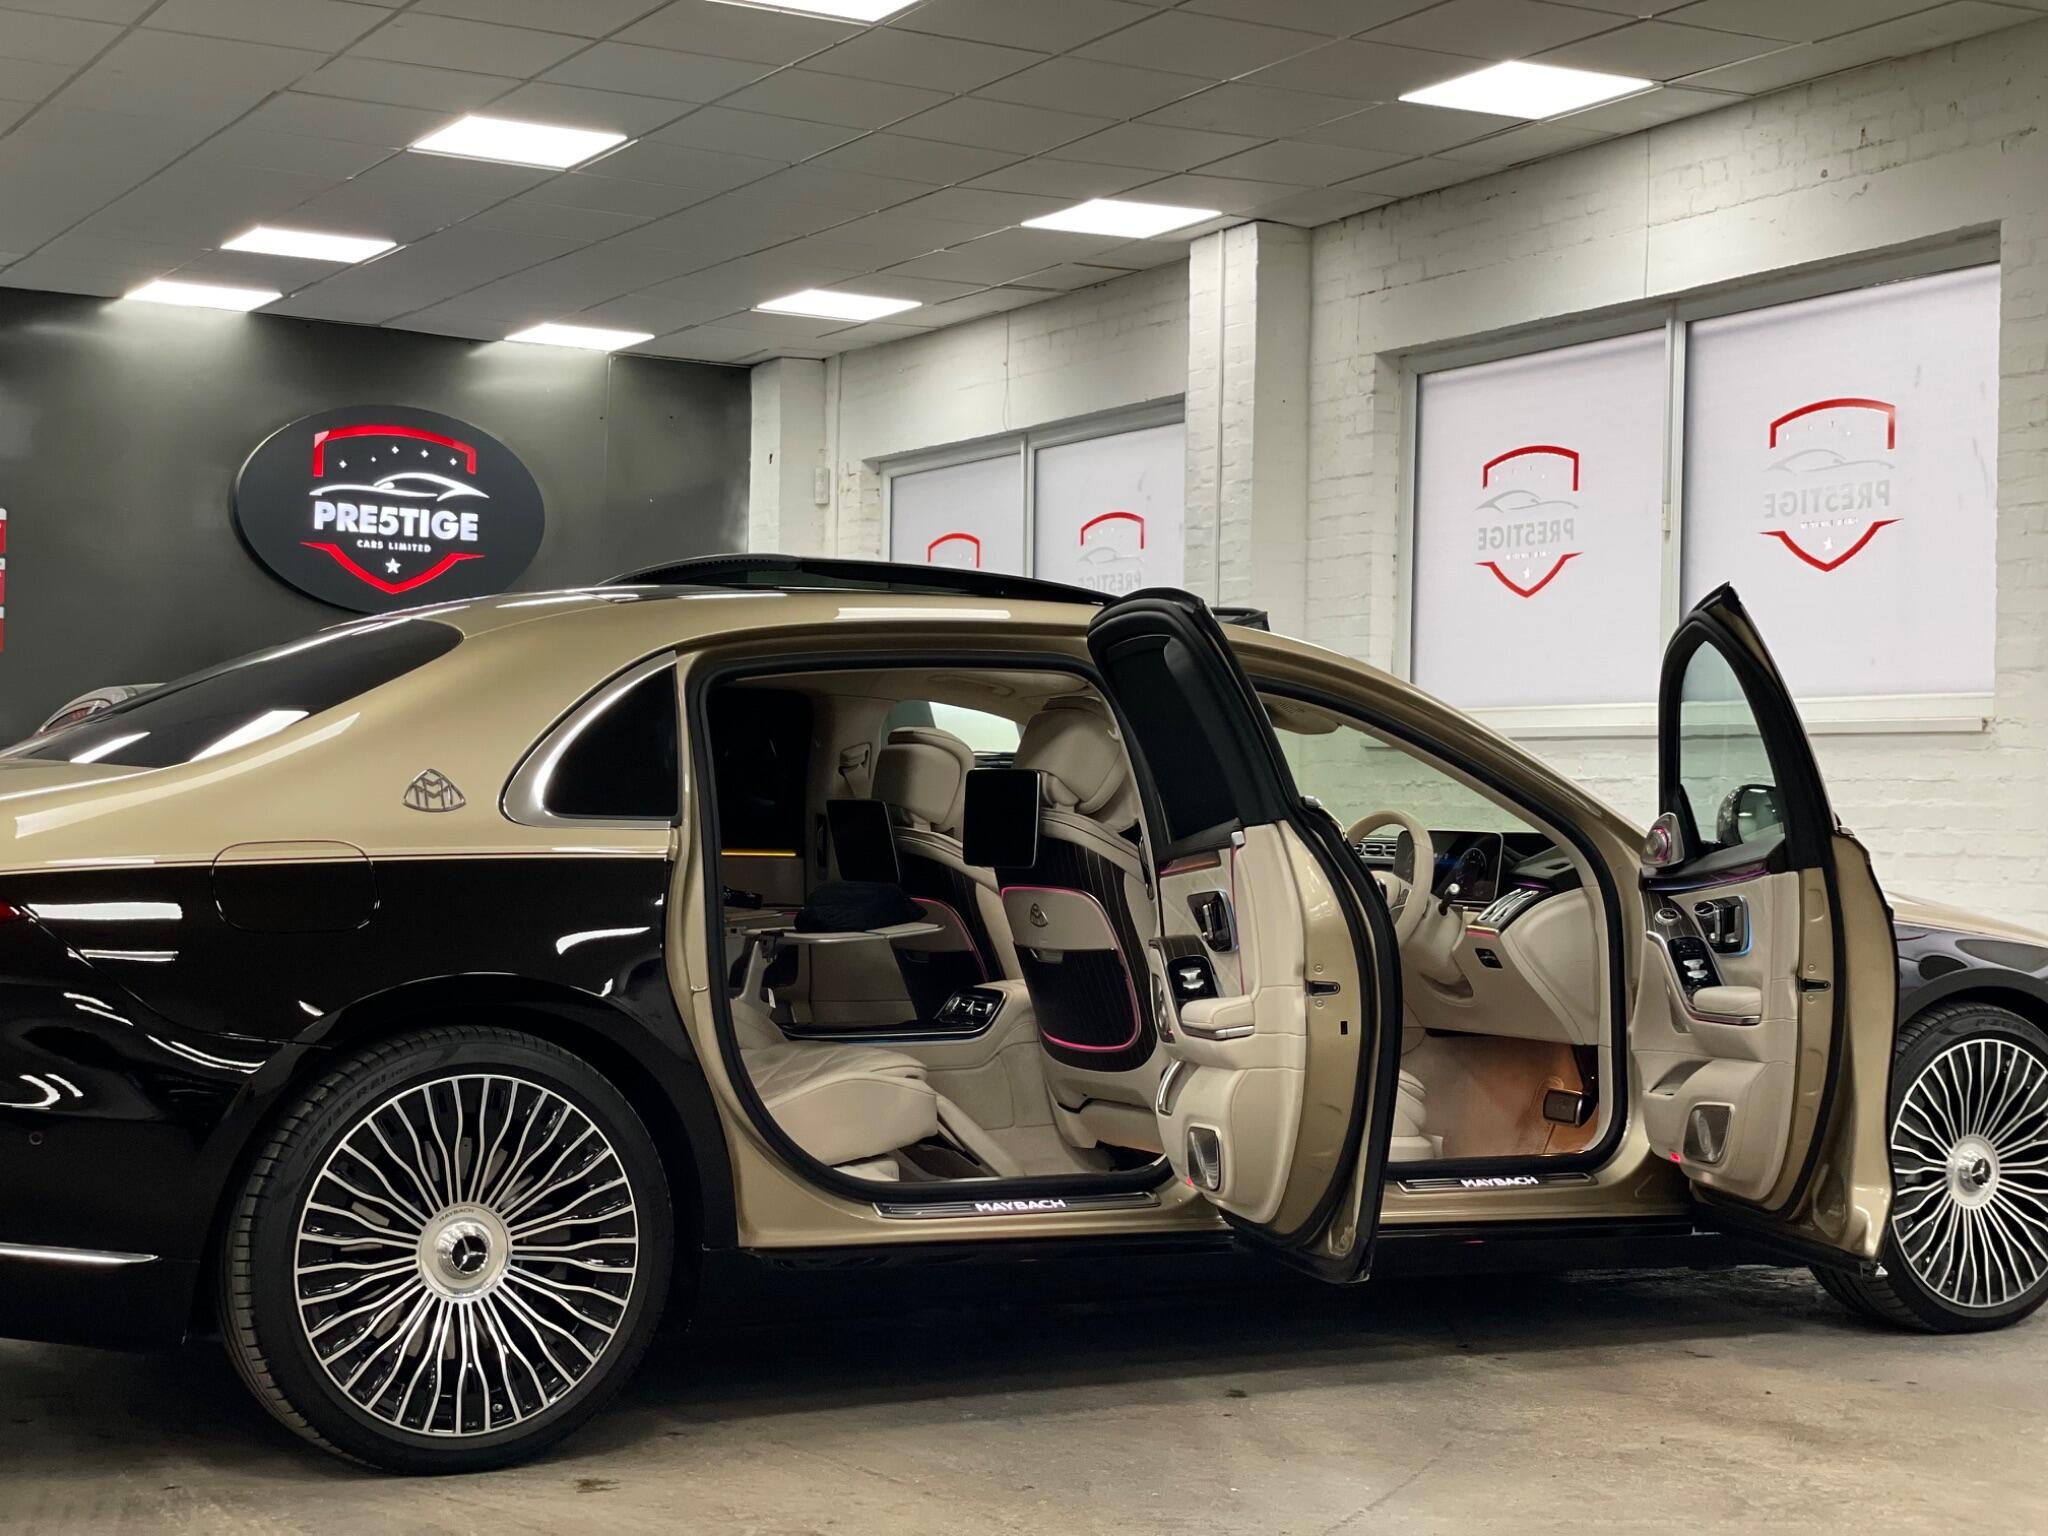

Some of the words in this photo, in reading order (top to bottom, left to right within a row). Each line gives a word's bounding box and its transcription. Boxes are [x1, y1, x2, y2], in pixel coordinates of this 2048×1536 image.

[356, 539, 384, 550] CARS
[388, 542, 432, 553] LIMITED
[1460, 1176, 1539, 1188] MAYBACH
[975, 1199, 1066, 1212] MAYBACH
[438, 1208, 475, 1222] MAYBACH
